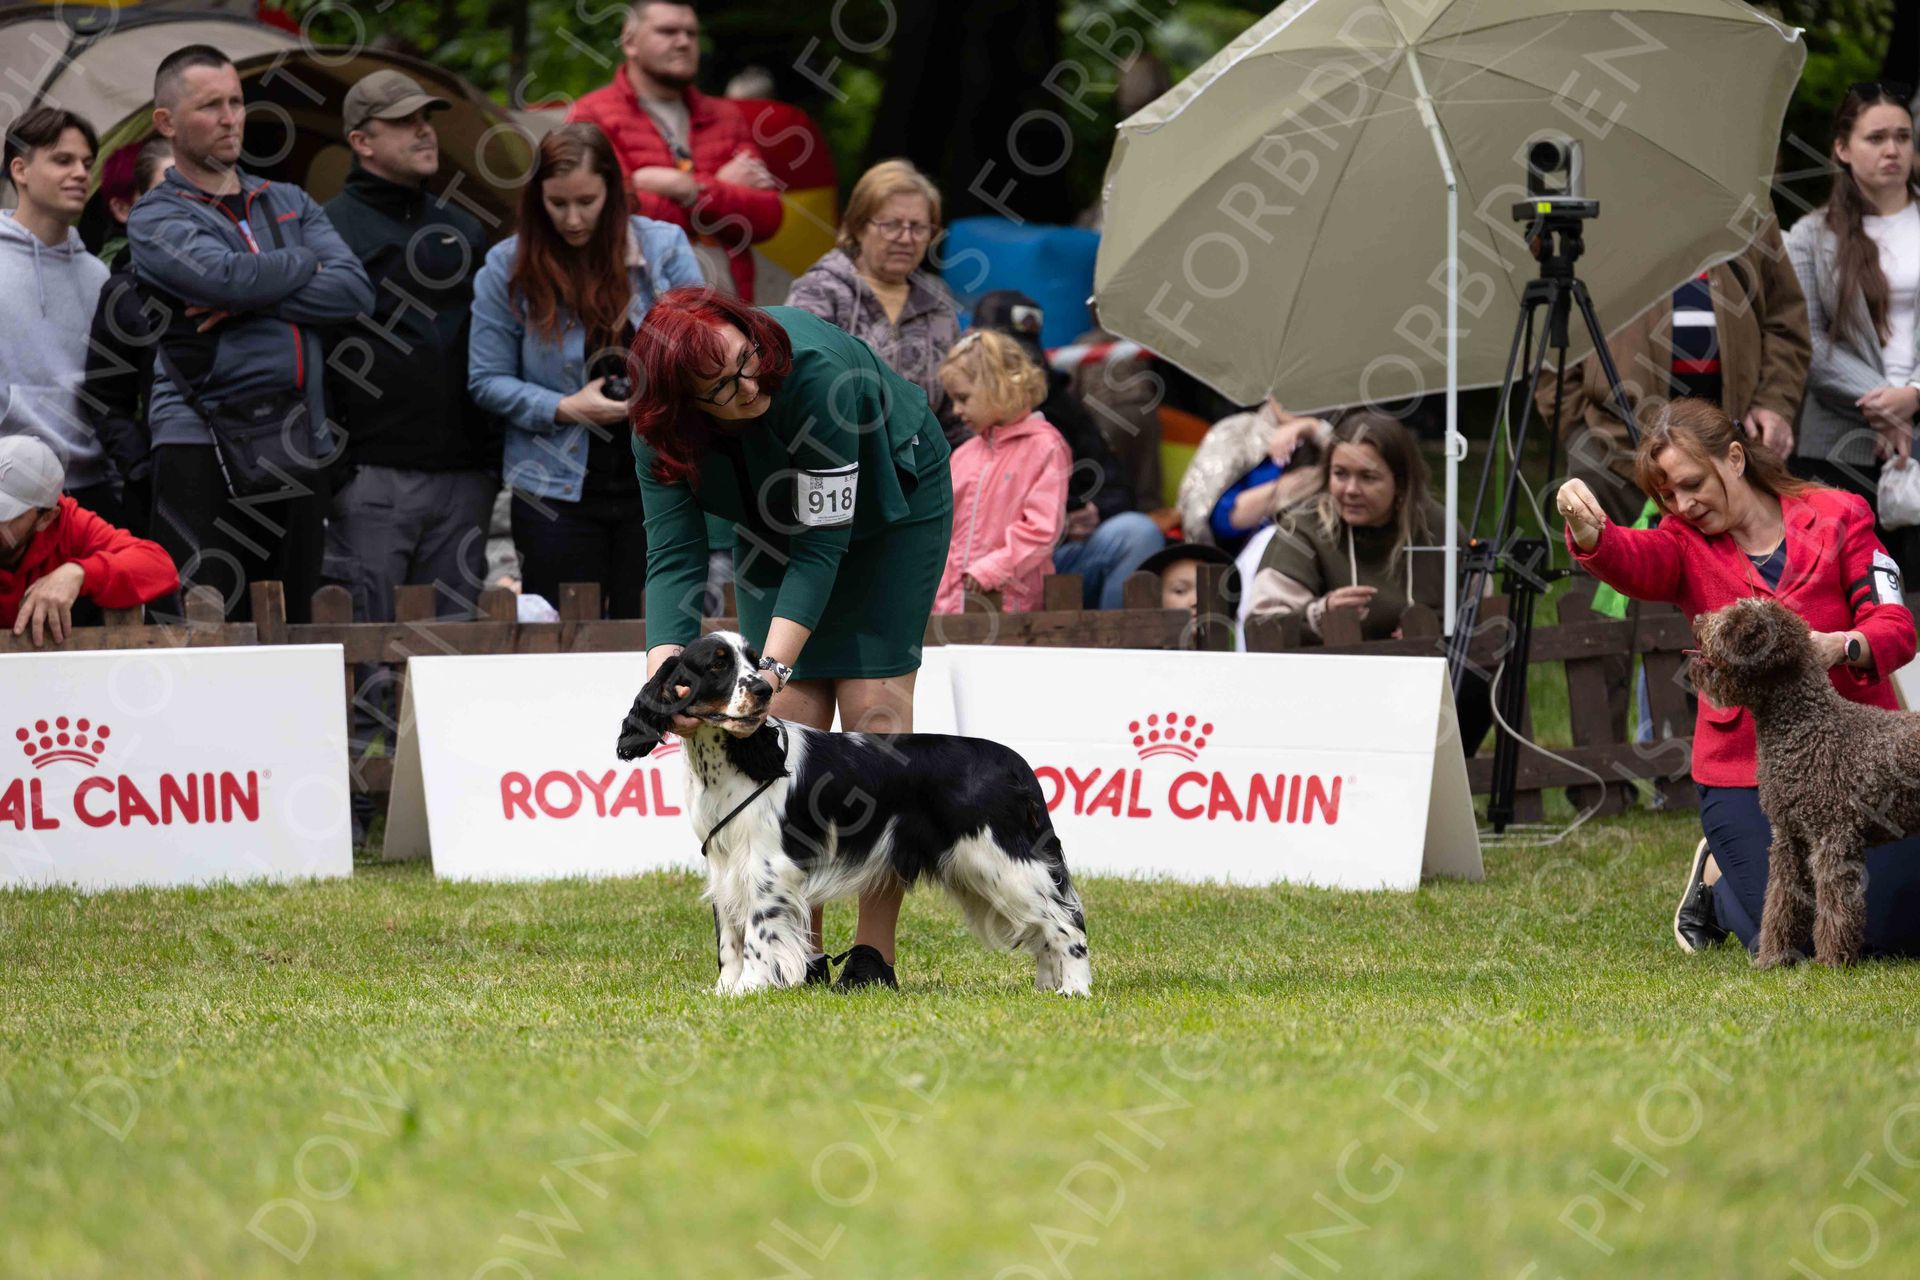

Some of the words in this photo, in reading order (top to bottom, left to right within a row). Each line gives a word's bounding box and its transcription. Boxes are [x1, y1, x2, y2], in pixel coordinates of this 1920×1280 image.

[808, 487, 853, 514] 918
[73, 770, 260, 828] CANIN
[500, 768, 681, 820] ROYAL
[1033, 766, 1152, 818] OYAL
[1168, 770, 1342, 825] CANIN
